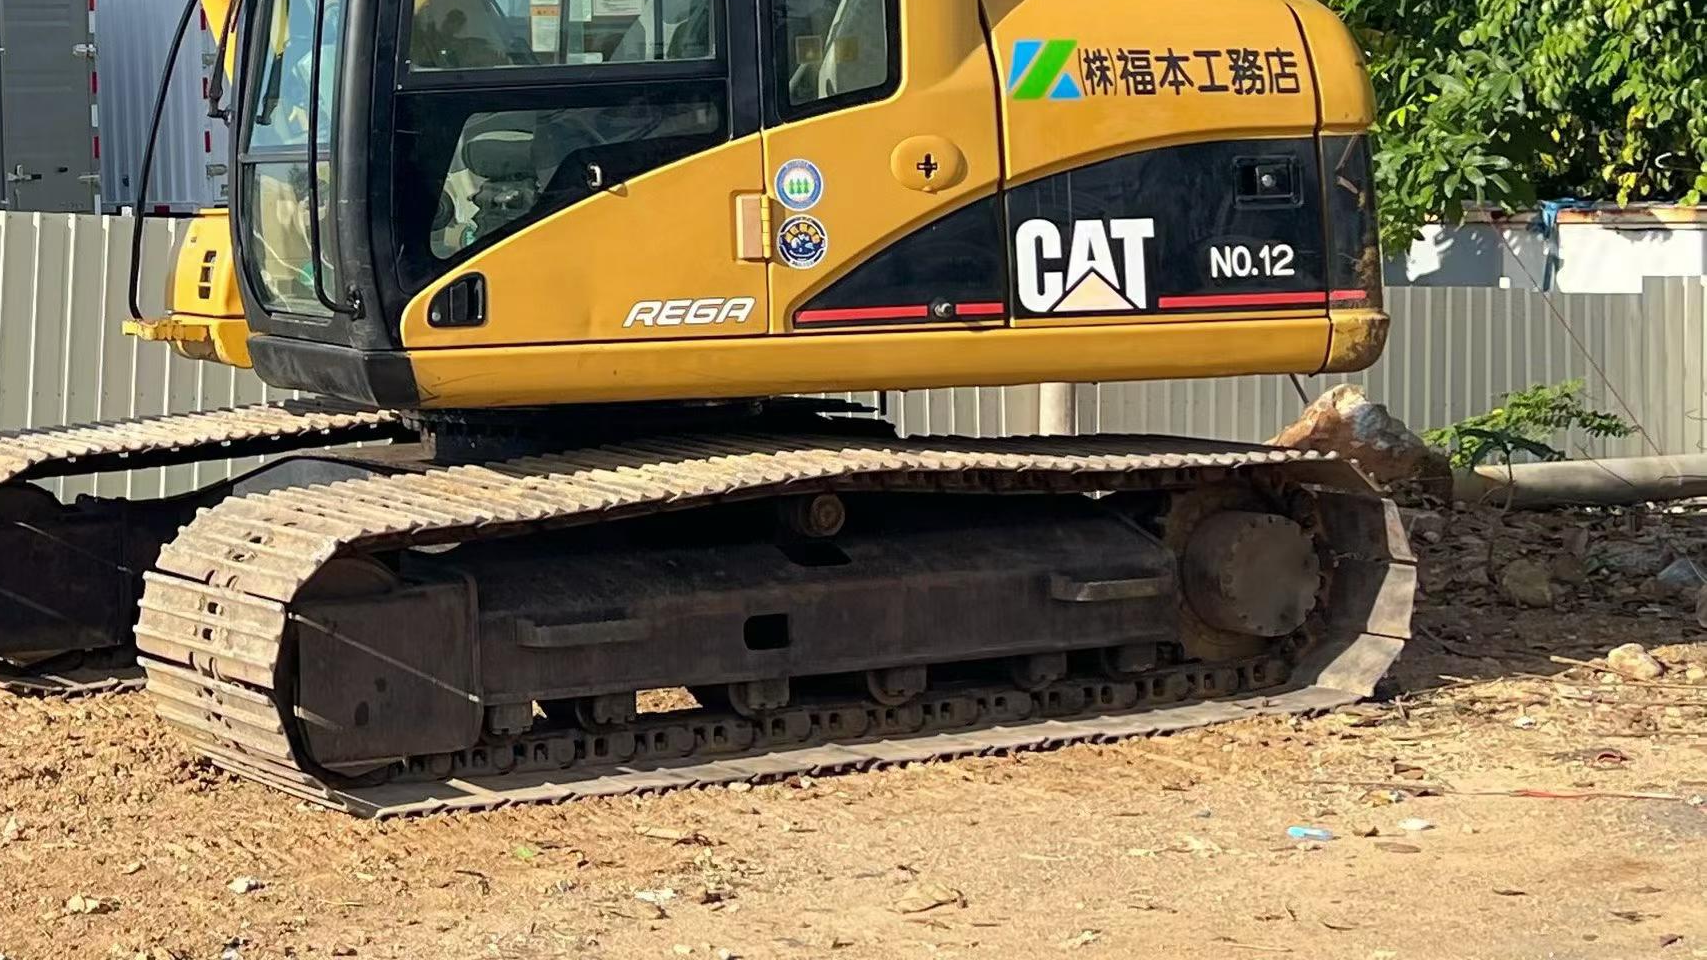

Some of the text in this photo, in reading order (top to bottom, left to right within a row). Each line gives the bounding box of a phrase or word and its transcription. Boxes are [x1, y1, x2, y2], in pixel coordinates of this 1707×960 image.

[1015, 218, 1155, 313] CAT
[1210, 244, 1296, 279] NO.12
[622, 296, 757, 328] REGA
